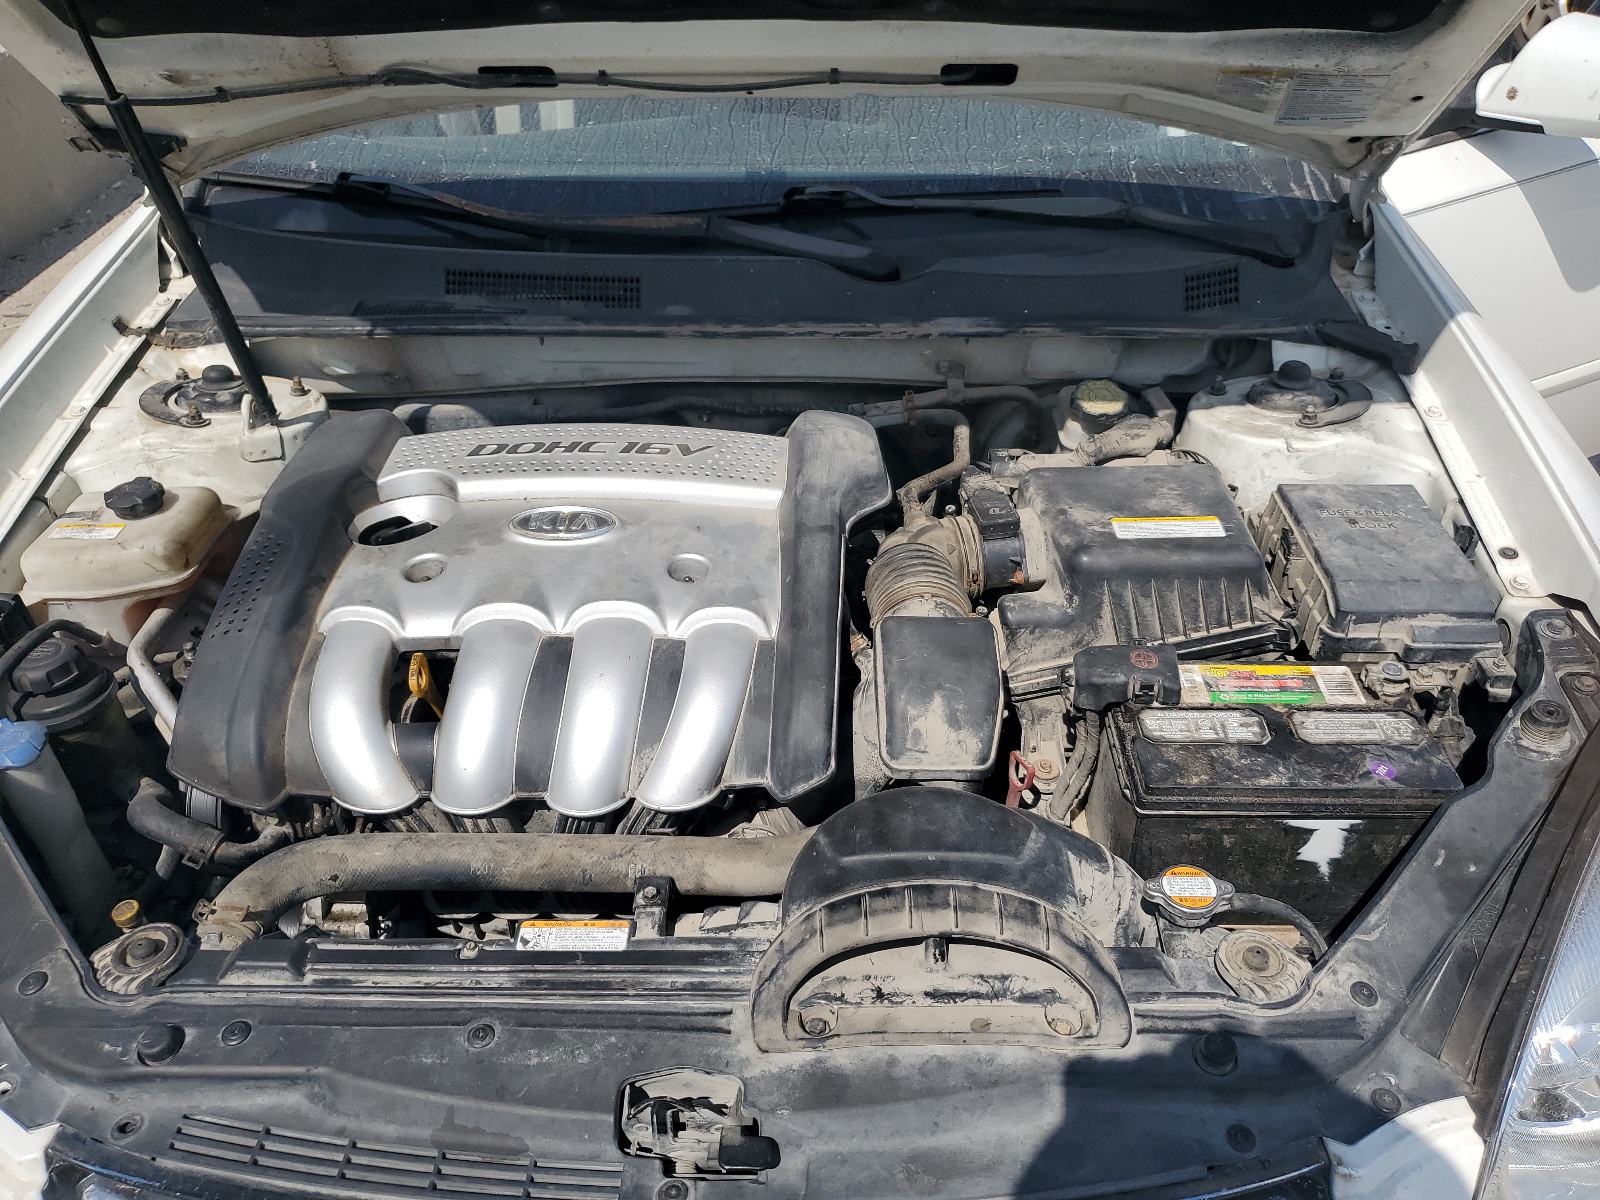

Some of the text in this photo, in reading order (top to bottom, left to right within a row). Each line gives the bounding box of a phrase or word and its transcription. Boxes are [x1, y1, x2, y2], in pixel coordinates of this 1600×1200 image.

[466, 441, 714, 457] DOHC 16V
[1319, 509, 1355, 517] FUSE
[1365, 509, 1408, 518] RELAY
[528, 513, 597, 531] KIA
[1348, 520, 1397, 529] BLOCK
